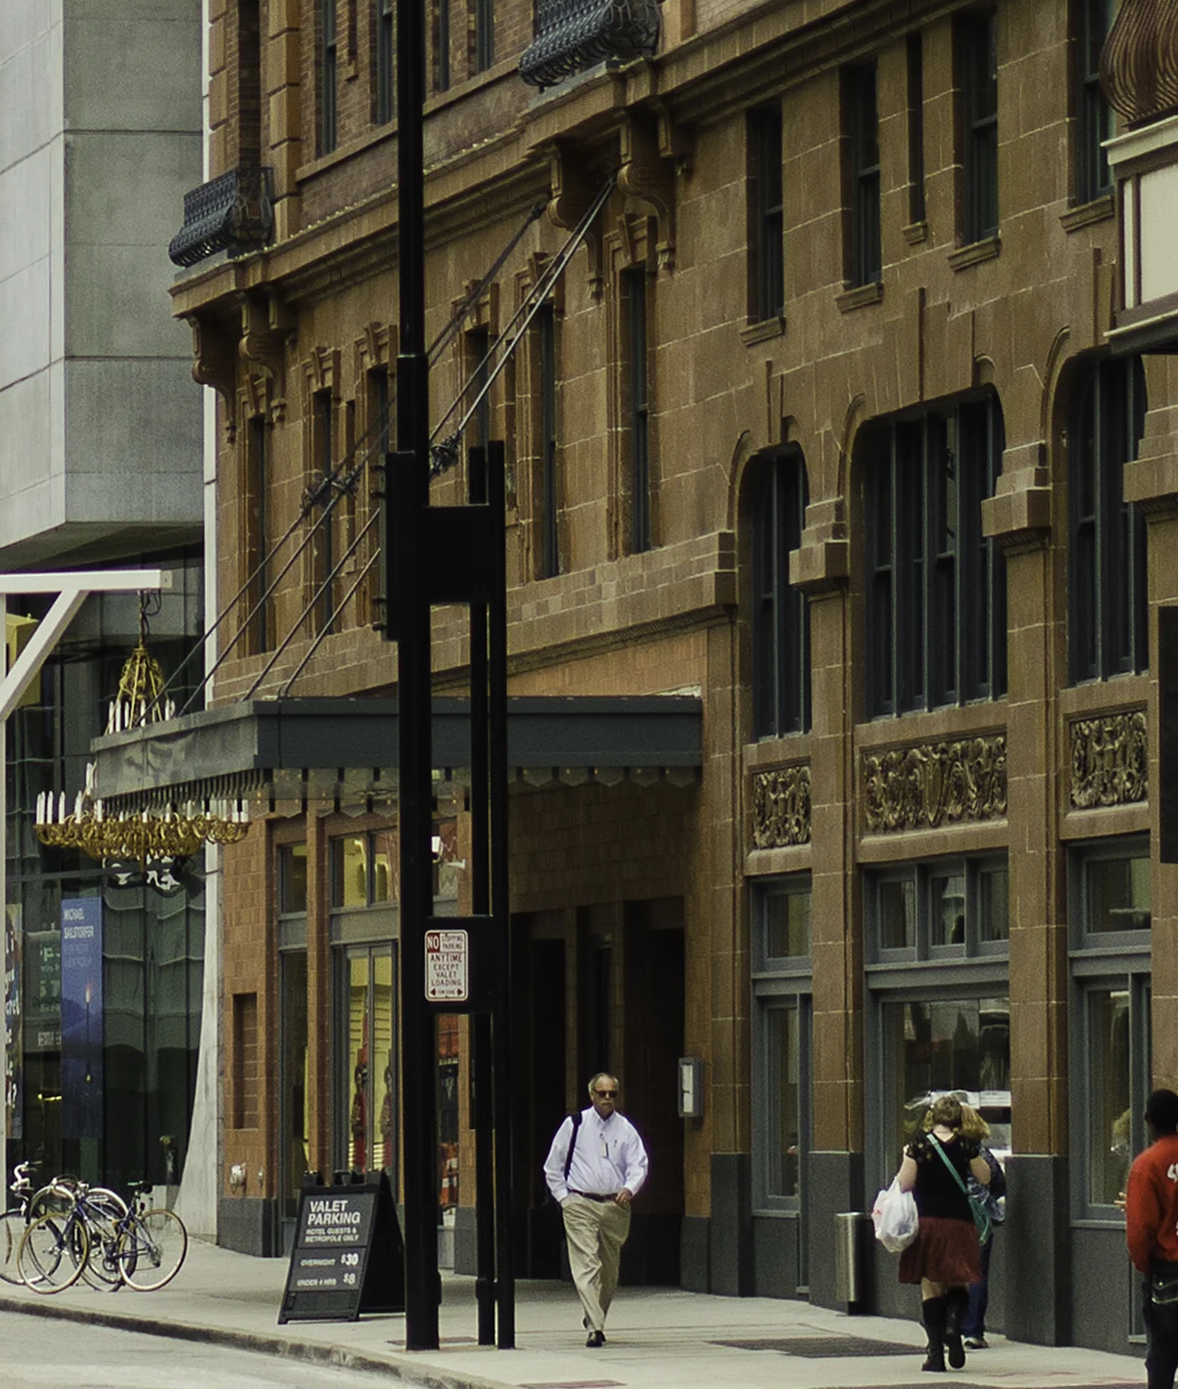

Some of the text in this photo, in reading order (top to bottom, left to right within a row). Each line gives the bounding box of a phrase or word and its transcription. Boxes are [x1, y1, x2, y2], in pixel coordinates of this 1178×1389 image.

[427, 936, 440, 950] NO
[310, 1200, 348, 1212] VALET
[307, 1212, 360, 1225] PARKING
[341, 1253, 358, 1266] $30
[343, 1273, 356, 1285] $8
